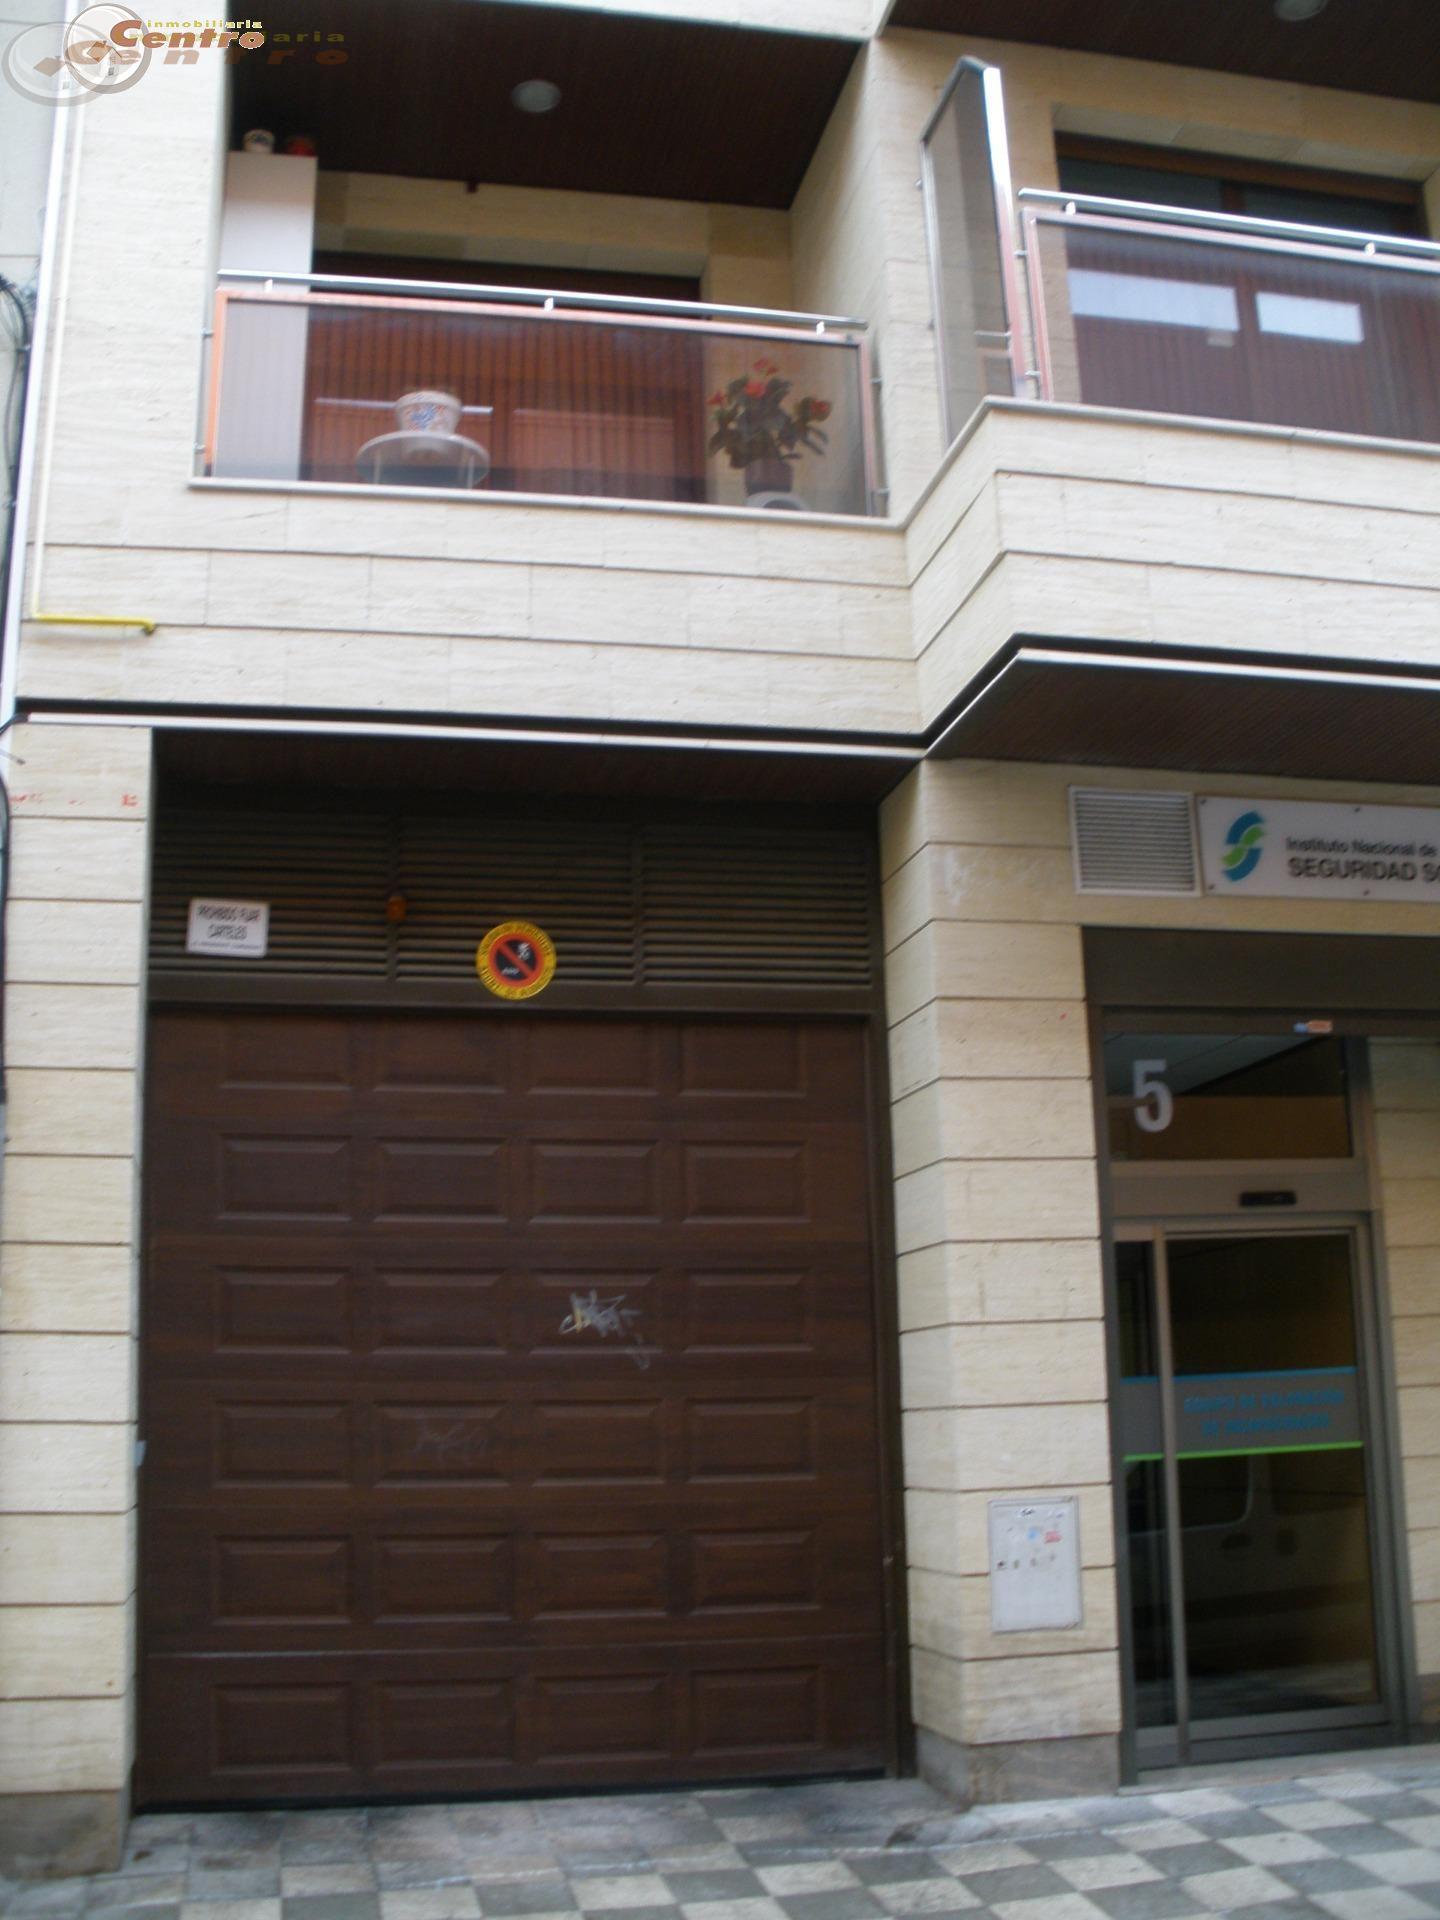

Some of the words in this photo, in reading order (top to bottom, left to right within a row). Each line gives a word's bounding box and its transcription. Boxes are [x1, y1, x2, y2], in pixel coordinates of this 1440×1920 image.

[1286, 837, 1349, 853] Instituto
[1352, 839, 1416, 856] Nacional
[1288, 857, 1418, 881] SEGURIDAD
[1133, 1059, 1173, 1132] 5
